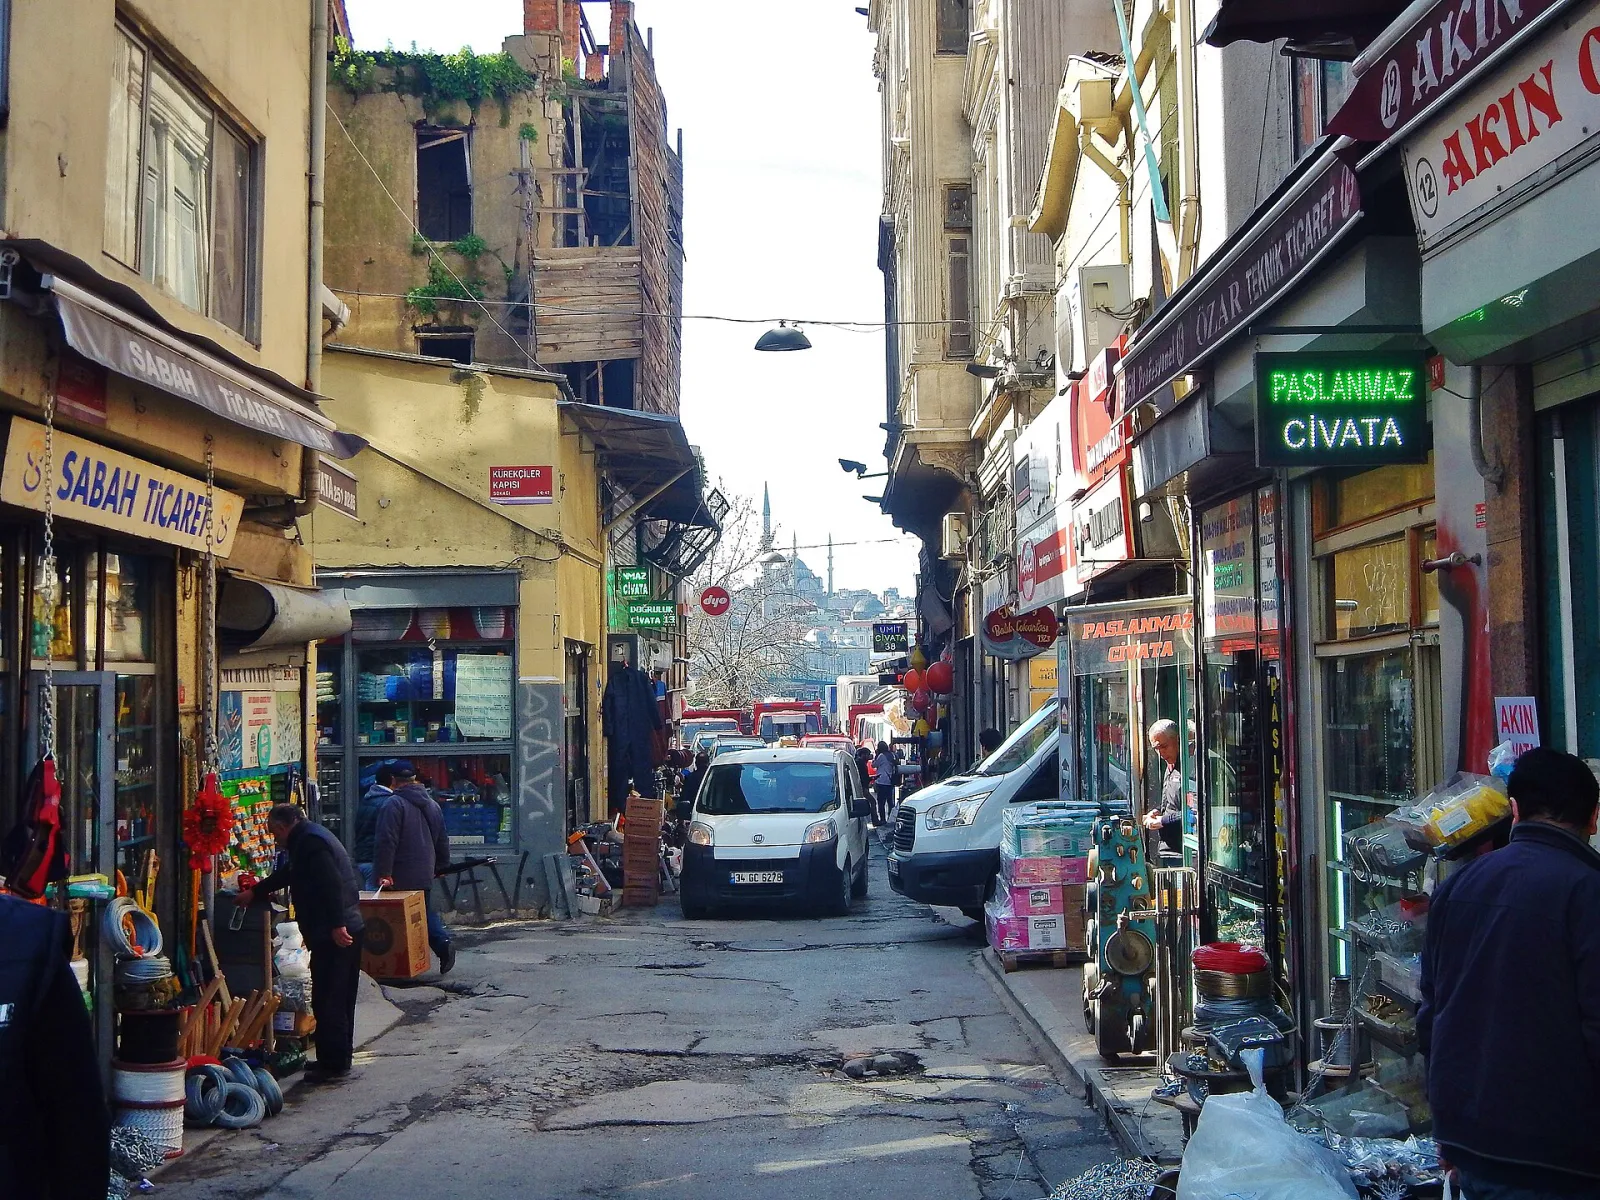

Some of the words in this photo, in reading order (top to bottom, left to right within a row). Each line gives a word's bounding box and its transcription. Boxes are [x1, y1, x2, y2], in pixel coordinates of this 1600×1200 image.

[1383, 69, 1396, 120] 12
[1419, 172, 1436, 203] 12
[1442, 60, 1563, 196] AKIN
[1195, 277, 1243, 346] ÖZAR
[1285, 185, 1335, 269] TİCARET
[129, 341, 199, 398] SABAH
[218, 384, 286, 431] TİCARET
[1271, 370, 1414, 402] PASLANMAZ
[1282, 414, 1405, 449] CİVATA
[492, 468, 541, 479] KÜREKÇİLER
[492, 480, 520, 489] KAPISI
[56, 450, 141, 518] SABAH
[143, 478, 212, 537] TİCARET
[629, 603, 674, 613] DOĞRULUK
[703, 594, 728, 608] dyo
[875, 634, 907, 642] CİVATA
[1081, 611, 1194, 640] PASLANMAZ
[884, 642, 896, 651] 38
[1107, 640, 1174, 663] CİVATA
[1501, 704, 1535, 735] AKIN
[735, 872, 746, 883] 34
[748, 872, 759, 883] GC
